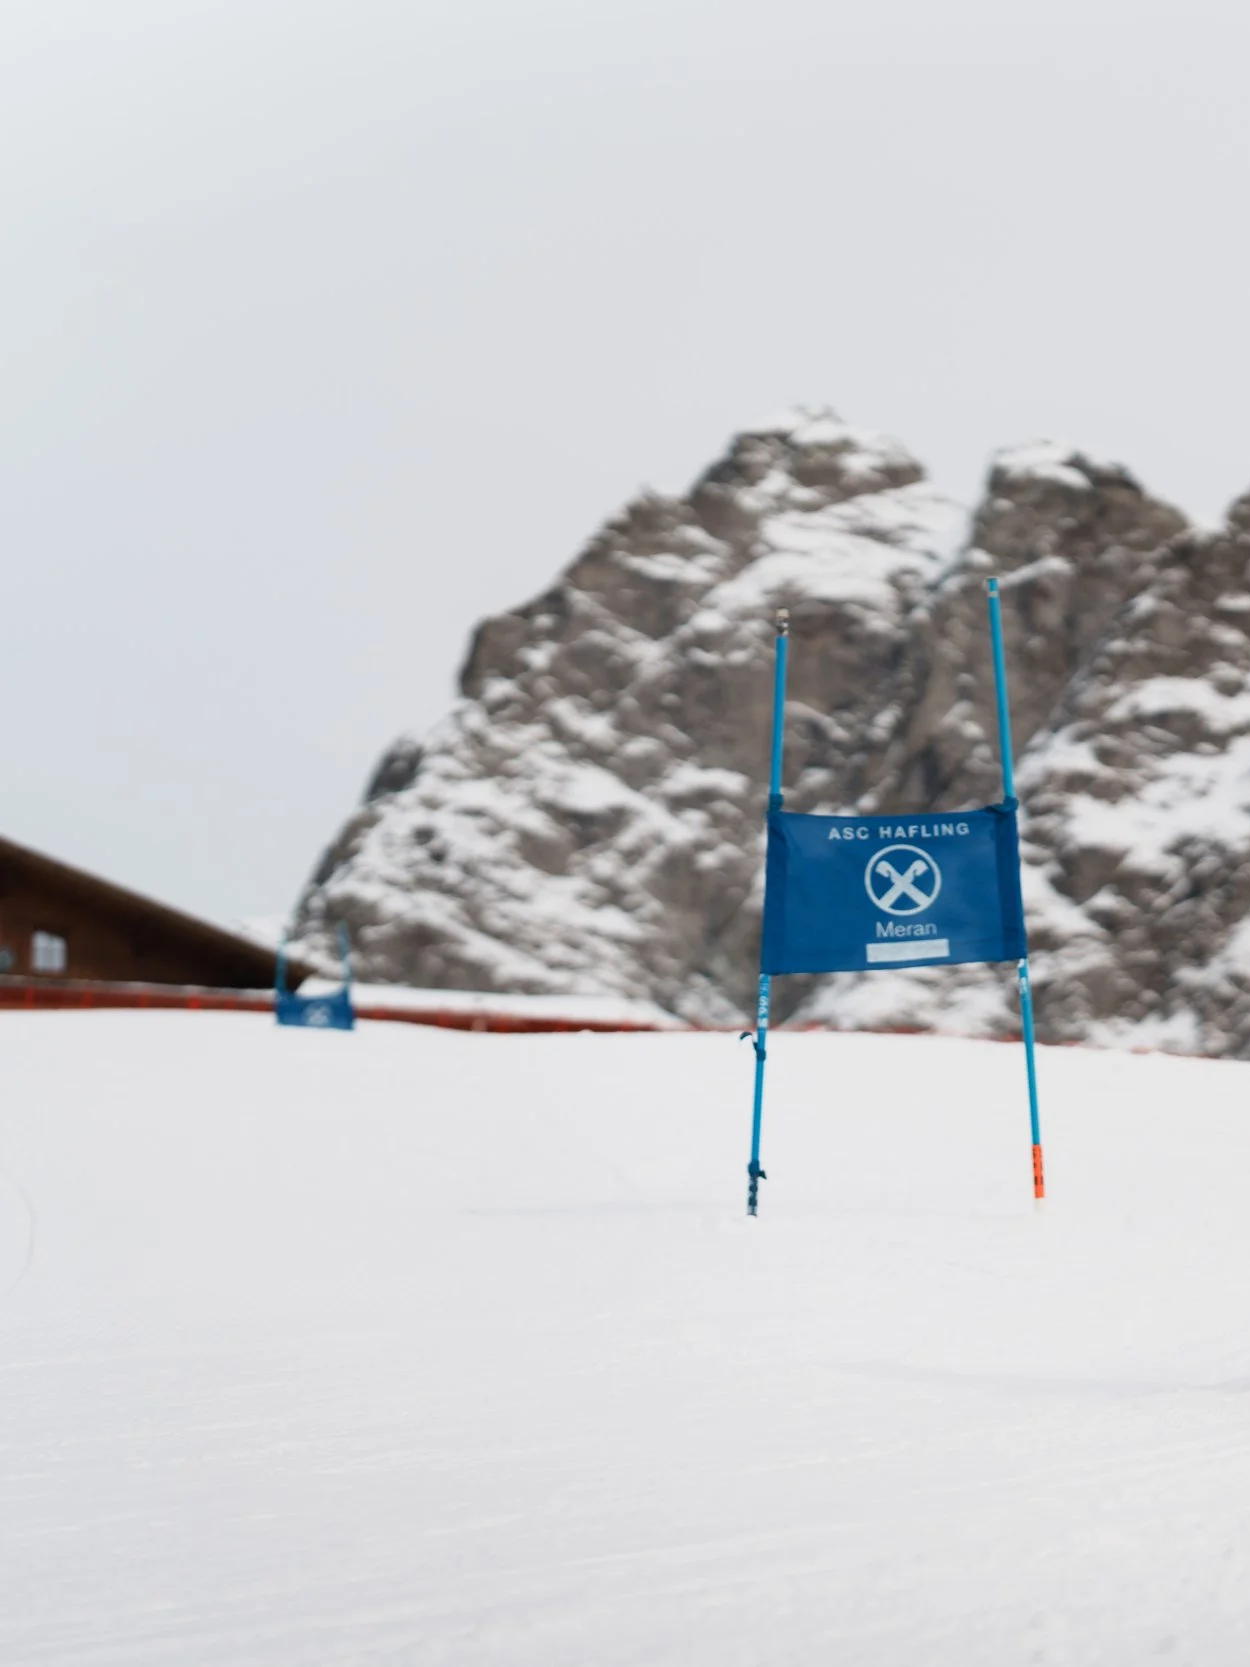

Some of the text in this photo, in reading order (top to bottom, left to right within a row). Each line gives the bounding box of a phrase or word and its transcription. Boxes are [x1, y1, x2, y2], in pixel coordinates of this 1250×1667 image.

[828, 823, 969, 840] ASC HAFLING
[876, 921, 937, 938] Meran
